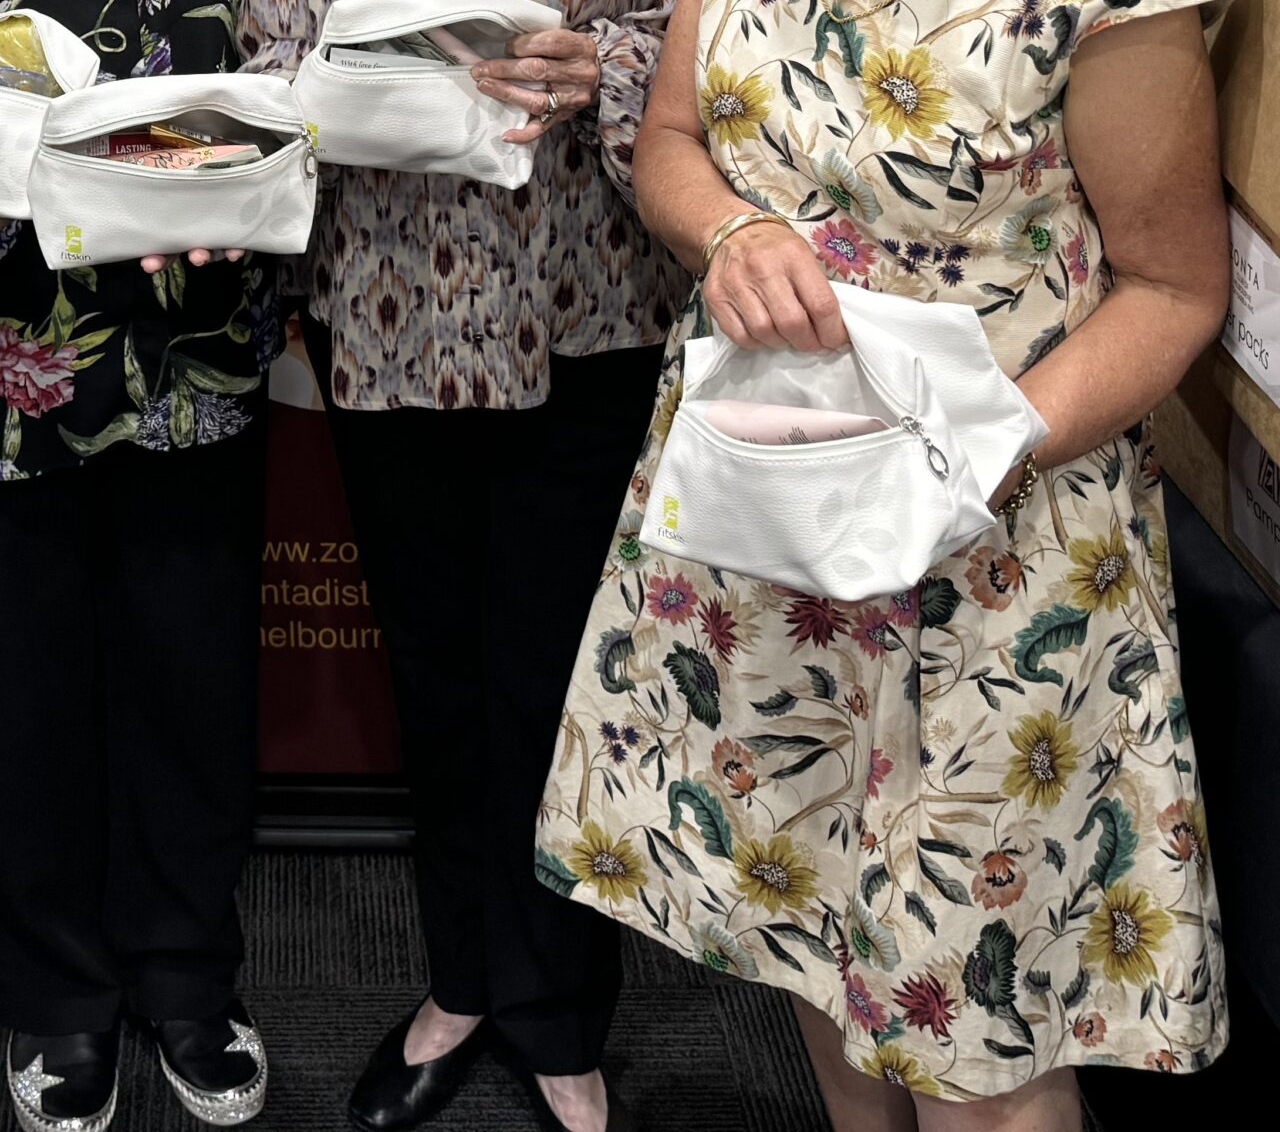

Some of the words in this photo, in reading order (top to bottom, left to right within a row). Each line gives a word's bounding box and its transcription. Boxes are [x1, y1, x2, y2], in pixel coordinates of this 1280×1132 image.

[115, 144, 152, 154] LASTING
[1238, 320, 1269, 370] packs
[261, 578, 370, 607] ntadist
